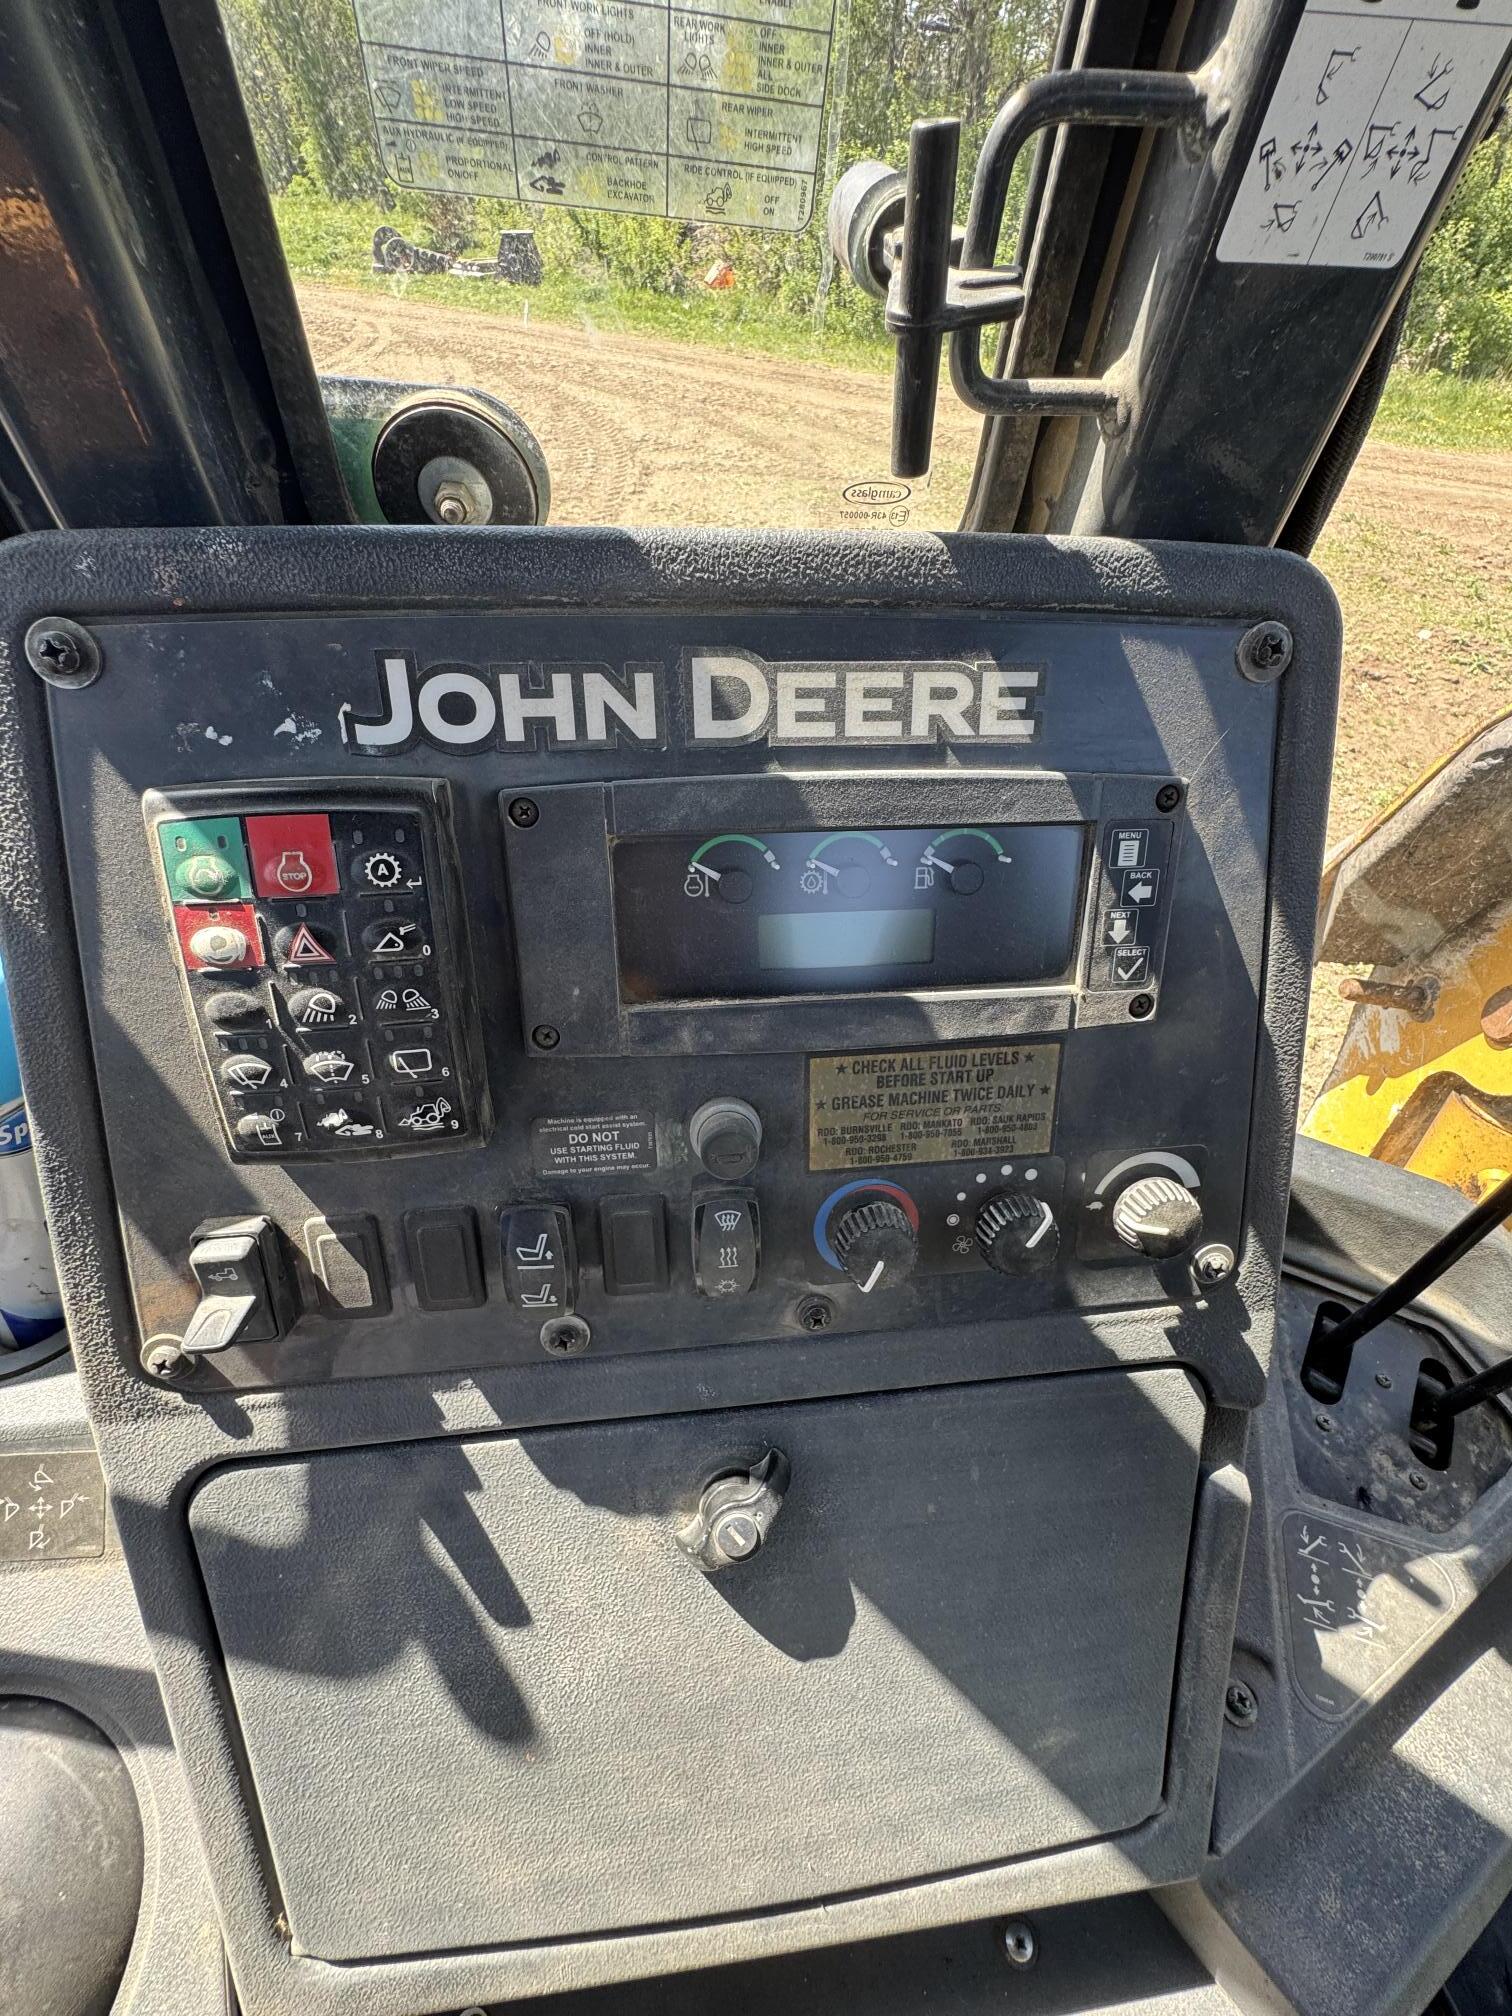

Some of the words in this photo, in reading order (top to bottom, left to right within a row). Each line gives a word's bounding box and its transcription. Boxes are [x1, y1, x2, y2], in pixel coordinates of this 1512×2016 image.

[538, 0, 566, 9] FRONT
[570, 1, 600, 14] WORK
[602, 5, 634, 19] LIGHTS
[674, 15, 698, 29] REAR
[700, 20, 726, 34] WORK
[584, 28, 600, 39] OFF
[604, 31, 635, 46] (HOLD)
[684, 31, 715, 45] LIGHTS
[760, 27, 777, 39] OFF
[584, 43, 612, 56] INNER
[758, 42, 785, 56] INNER
[388, 55, 418, 70] FRONT
[421, 60, 450, 74] WIPER
[454, 64, 484, 78] SPEED
[585, 58, 612, 72] INNER
[615, 63, 621, 72] &
[623, 64, 654, 77] OUTER
[758, 54, 784, 68] INNER
[786, 61, 792, 70] &
[794, 61, 823, 75] OUTER
[758, 70, 773, 81] ALL
[442, 81, 506, 101] INTERMITTENT
[554, 78, 583, 92] FRONT
[586, 83, 624, 98] WASHER
[756, 82, 774, 95] SIDE
[777, 85, 801, 98] DOCK
[444, 98, 465, 110] LOW
[468, 100, 497, 114] SPEED
[722, 102, 744, 114] REAR
[746, 105, 774, 118] WIPER
[470, 114, 500, 128] SPEED
[384, 126, 400, 136] AUX
[404, 128, 454, 144] HYDRAULIC
[468, 138, 508, 150] EQUIPPED)
[744, 128, 802, 144] INTERMITTENT
[744, 141, 764, 152] HIGH
[766, 144, 792, 156] SPEED
[446, 155, 513, 172] PROPORTIONAL
[586, 152, 623, 166] CONTROL
[625, 156, 659, 169] PATTERN
[448, 170, 479, 181] ON/OFF
[684, 164, 703, 176] RIDE
[705, 167, 744, 181] CONTROL
[746, 172, 754, 182] (IF
[756, 175, 797, 189] EQUIPPED)
[607, 177, 648, 191] BACKHOE
[608, 191, 655, 204] EXCAVATOR
[764, 195, 780, 205] OFF
[763, 207, 775, 216] ON
[353, 656, 657, 747] JOHN
[691, 655, 1040, 741] DEERE
[1118, 832, 1142, 840] MENU
[282, 872, 307, 880] STOP
[378, 863, 390, 876] A
[422, 944, 432, 956] 0
[1116, 948, 1147, 956] SELECT
[348, 1014, 358, 1025] 2
[430, 1008, 440, 1020] 3
[266, 1018, 272, 1030] 1
[852, 1058, 896, 1074] CHECK
[900, 1057, 925, 1072] ALL
[929, 1054, 966, 1070] FLUID
[972, 1051, 1020, 1067] LEVELS
[441, 1067, 450, 1077] 6
[876, 1072, 926, 1089] BEFORE
[930, 1070, 972, 1086] START
[976, 1068, 994, 1082] UP
[280, 1078, 289, 1088] 4
[361, 1074, 370, 1085] 5
[832, 1094, 884, 1111] GREASE
[888, 1089, 949, 1106] MACHINE
[953, 1086, 994, 1102] TWICE
[997, 1084, 1036, 1099] DAILY
[583, 1116, 614, 1124] equipped
[863, 1112, 888, 1122] FOR
[890, 1106, 942, 1120] SERVICE
[944, 1106, 961, 1116] OR
[970, 1116, 990, 1126] RDO:
[992, 1114, 1014, 1124] SAUK
[1016, 1112, 1046, 1122] RAPIDS
[450, 1119, 460, 1130] 9
[818, 1128, 838, 1136] RDO:
[841, 1123, 892, 1134] BURNSVILLE
[922, 1118, 962, 1129] MANKATO
[294, 1132, 302, 1142] 7
[375, 1129, 384, 1139] 8
[568, 1133, 588, 1144] DO
[592, 1131, 620, 1142] NOT
[974, 1136, 1016, 1146] MARSHALL
[570, 1144, 613, 1154] STARTING
[615, 1142, 640, 1150] FLUID
[868, 1142, 916, 1154] ROCHESTER
[554, 1156, 576, 1164] WITH
[578, 1154, 598, 1162] THIS
[542, 1168, 568, 1176] Damage
[616, 1164, 630, 1172] may
